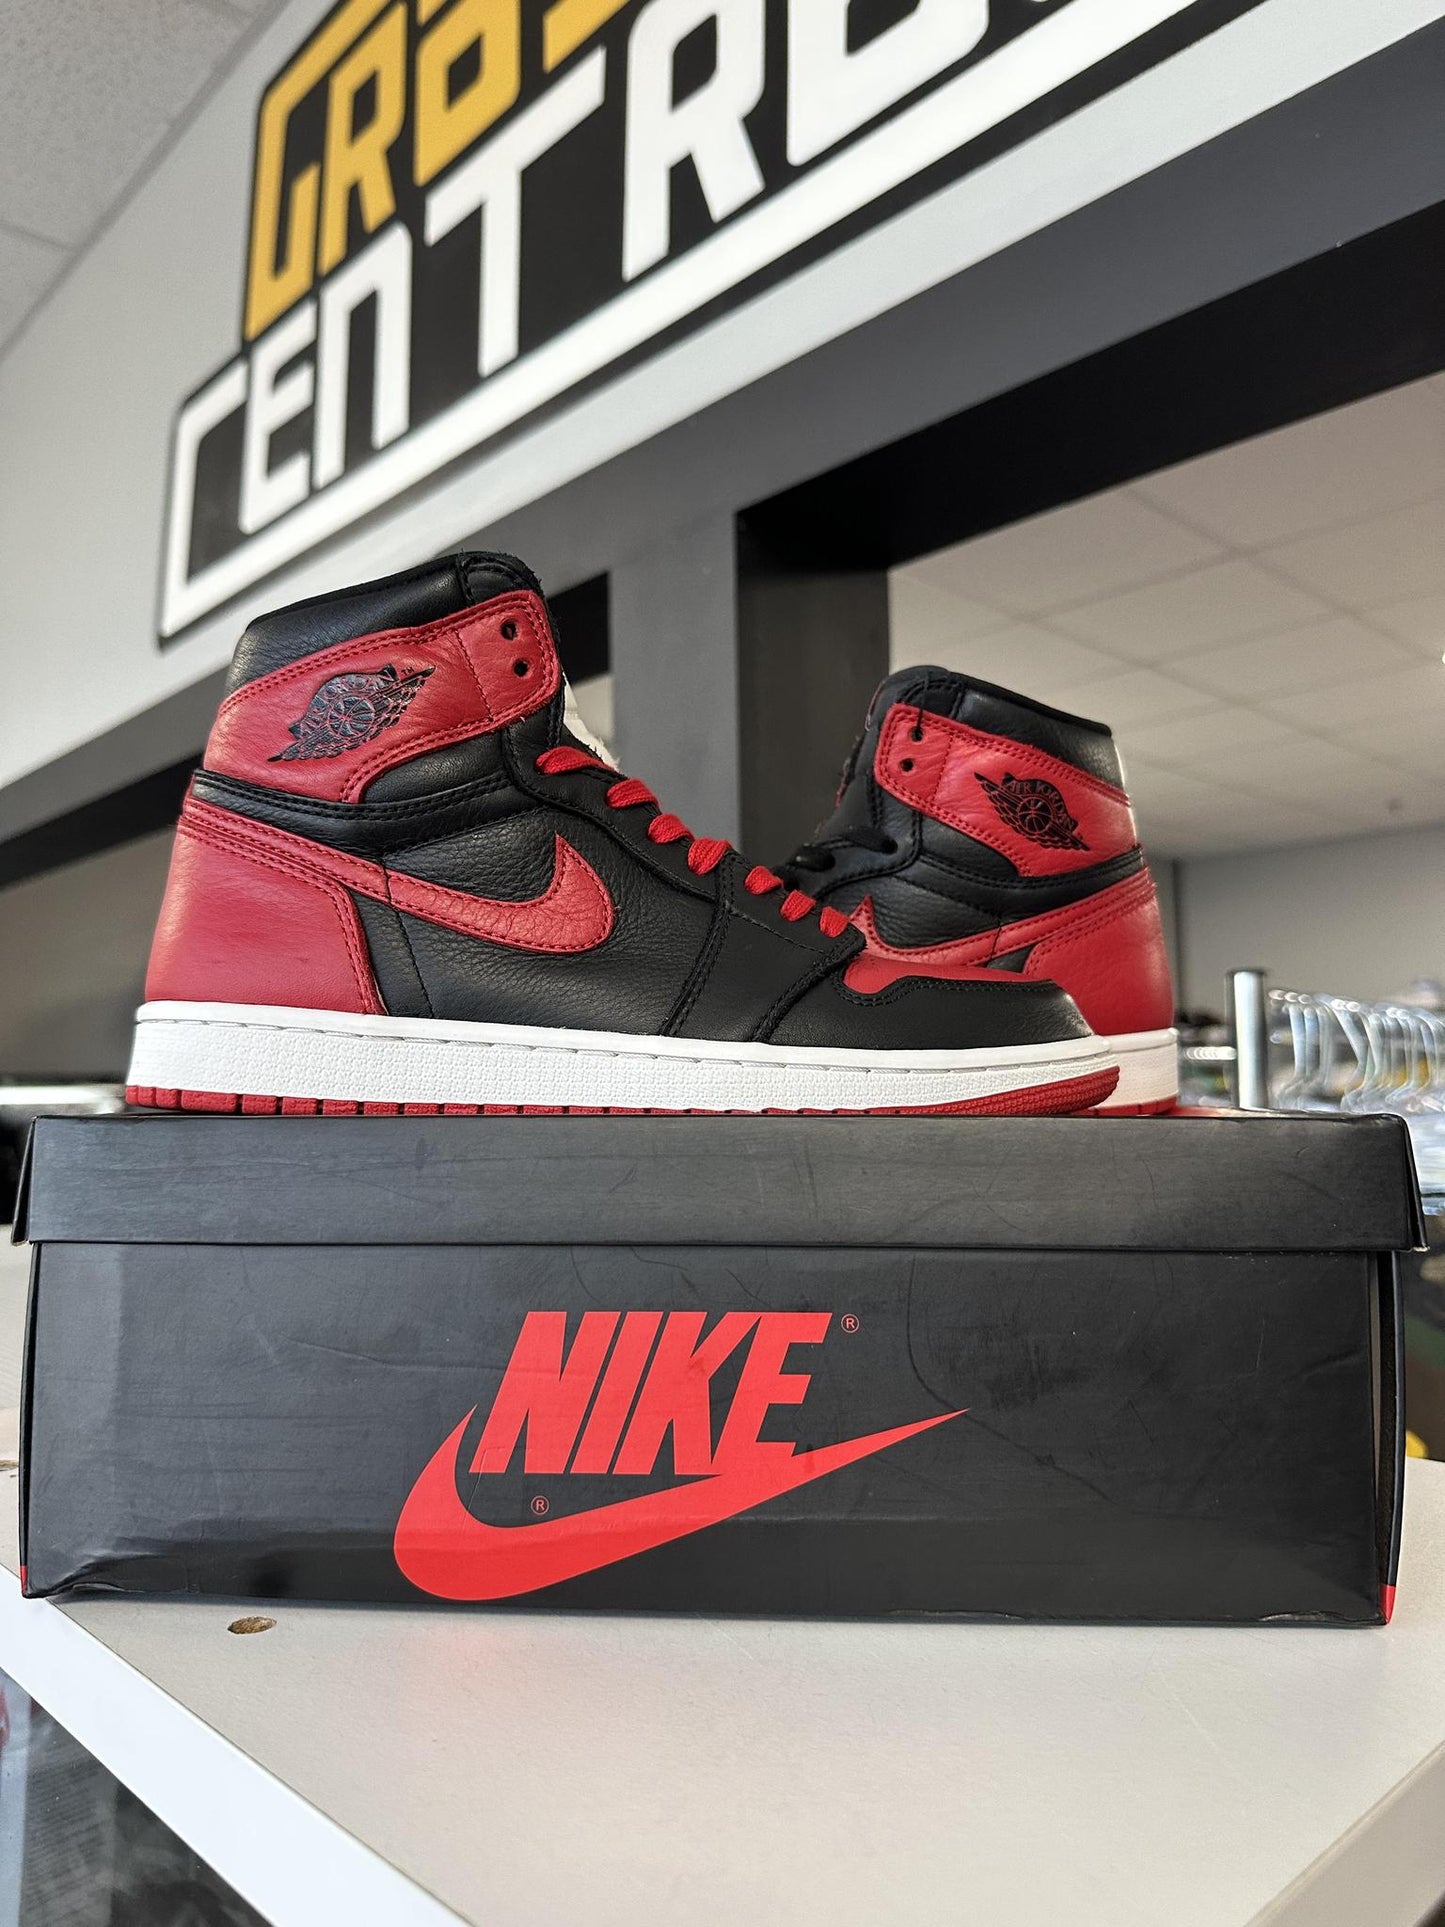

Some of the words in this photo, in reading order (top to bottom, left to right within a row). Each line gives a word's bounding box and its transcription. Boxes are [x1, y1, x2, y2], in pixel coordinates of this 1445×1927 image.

[1005, 779, 1033, 795] AIR
[1035, 780, 1075, 832] JORDAN
[468, 1311, 832, 1475] NIKE
